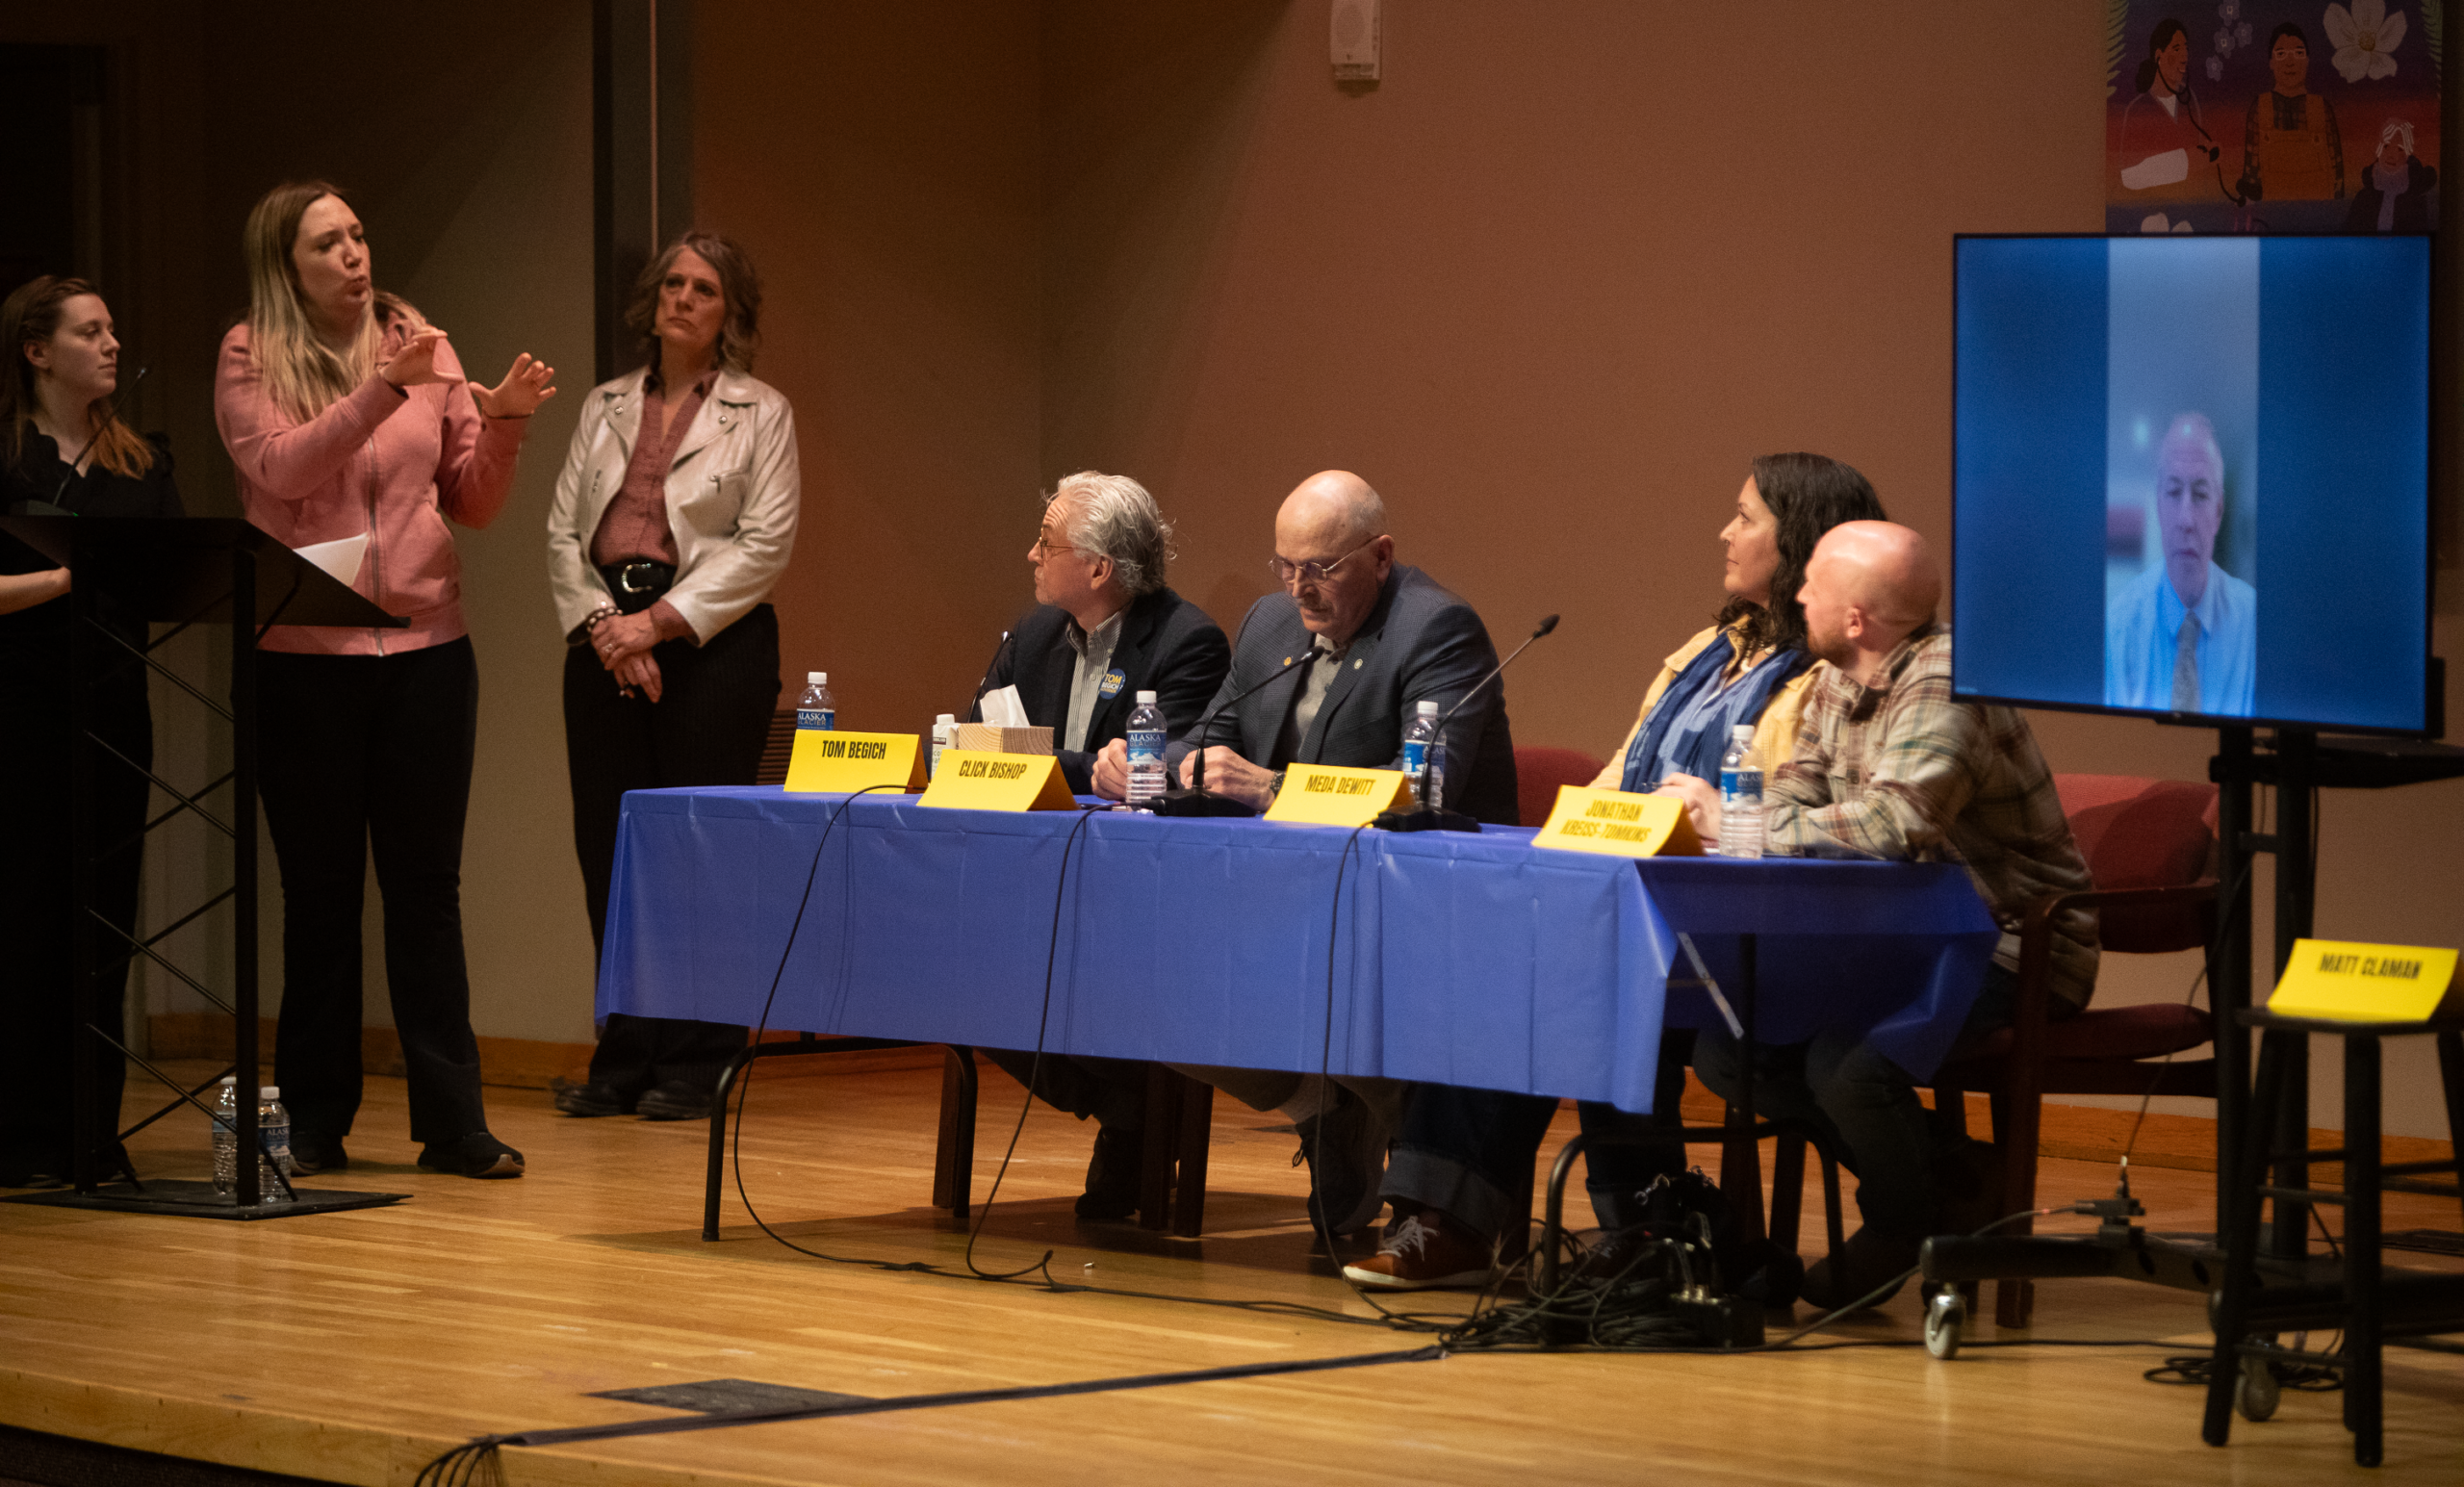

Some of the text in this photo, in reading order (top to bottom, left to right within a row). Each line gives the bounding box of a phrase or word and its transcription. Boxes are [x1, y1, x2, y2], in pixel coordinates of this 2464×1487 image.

[1104, 673, 1122, 683] TOM
[1130, 733, 1161, 742] ALASKA
[822, 740, 886, 759] TOM BEGICH
[959, 759, 1027, 780] CLICK BISHOP
[1737, 773, 1760, 782] ALAS
[1304, 775, 1376, 795] MEDA DEWITT
[1585, 799, 1644, 822] JONATHAN
[1559, 818, 1653, 843] KREISS-TOMKINS
[2318, 953, 2424, 980] MATT CLAMAN
